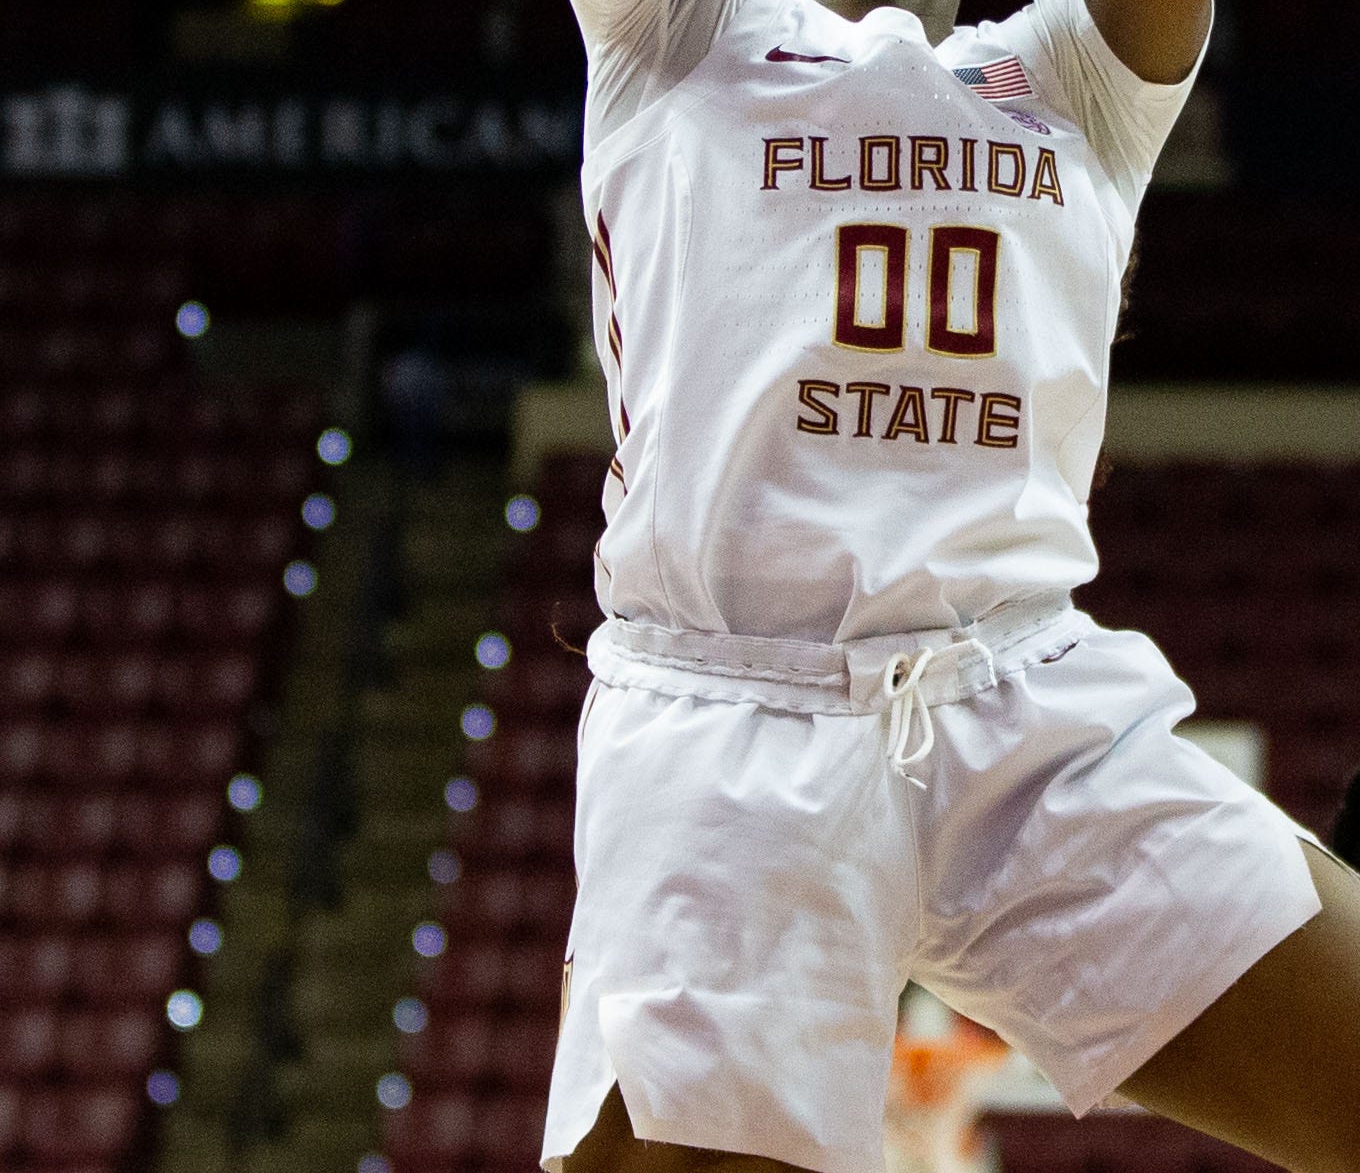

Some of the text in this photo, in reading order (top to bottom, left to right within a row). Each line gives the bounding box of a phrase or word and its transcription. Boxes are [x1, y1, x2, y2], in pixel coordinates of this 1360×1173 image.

[761, 135, 1064, 207] FLORIDA
[832, 222, 1002, 359] 00
[797, 379, 1022, 449] STATE
